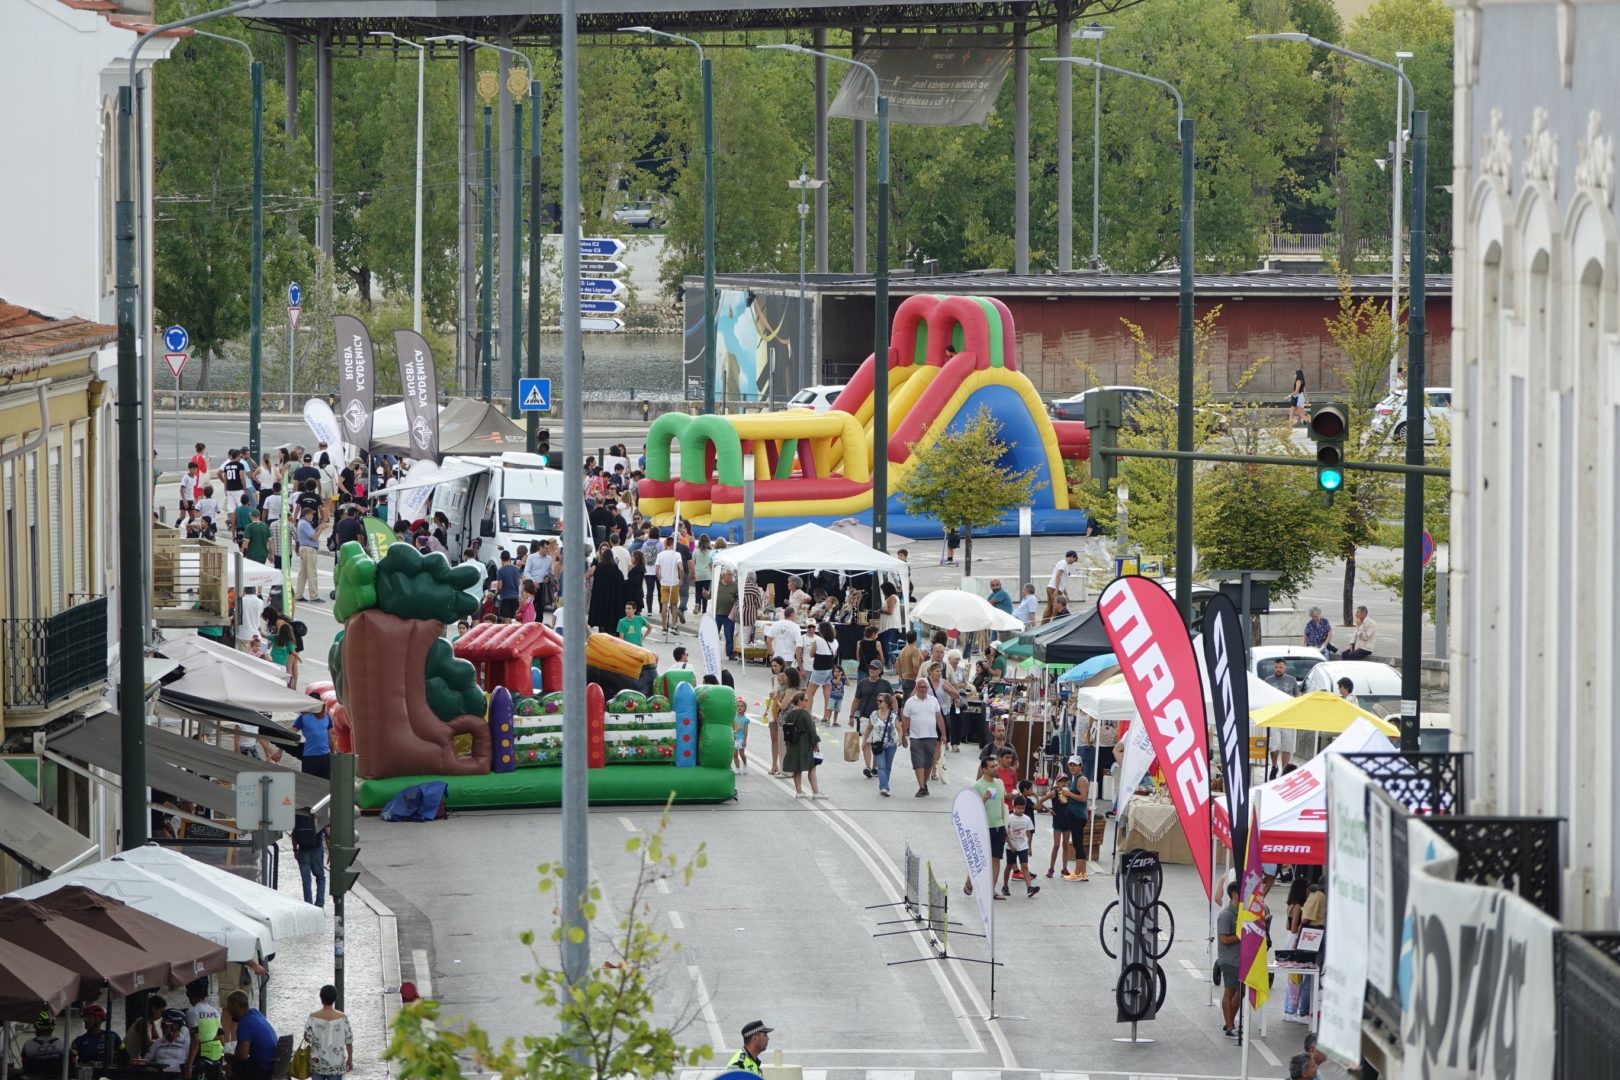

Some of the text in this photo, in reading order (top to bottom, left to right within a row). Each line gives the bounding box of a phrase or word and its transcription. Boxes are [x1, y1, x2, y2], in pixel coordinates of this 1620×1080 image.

[227, 469, 236, 481] 01
[1262, 844, 1312, 853] SRAM
[199, 1011, 218, 1019] EFAPE
